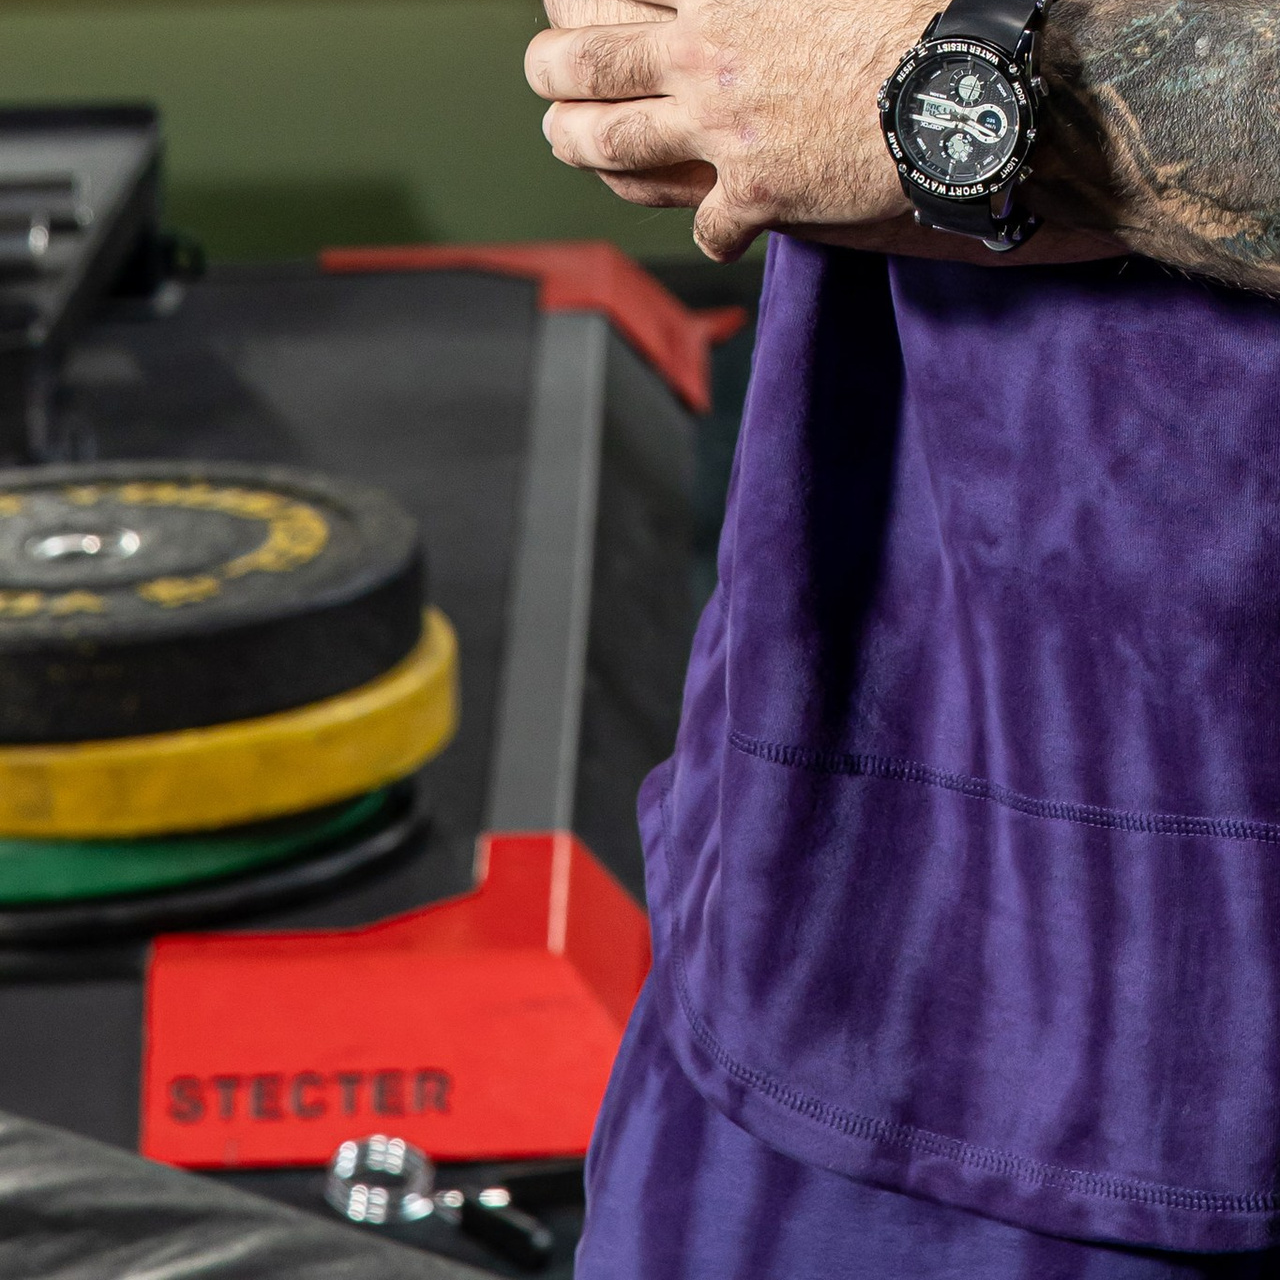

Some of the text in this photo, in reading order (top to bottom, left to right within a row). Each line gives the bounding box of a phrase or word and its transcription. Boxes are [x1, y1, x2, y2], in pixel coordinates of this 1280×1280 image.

[936, 42, 1000, 66] WATER RESIST
[896, 60, 917, 83] RESET
[1012, 81, 1027, 105] MODE
[886, 131, 903, 159] START
[1000, 156, 1019, 179] LIGHT
[910, 170, 985, 197] SPORT WATCH
[168, 1067, 453, 1124] STECTER
